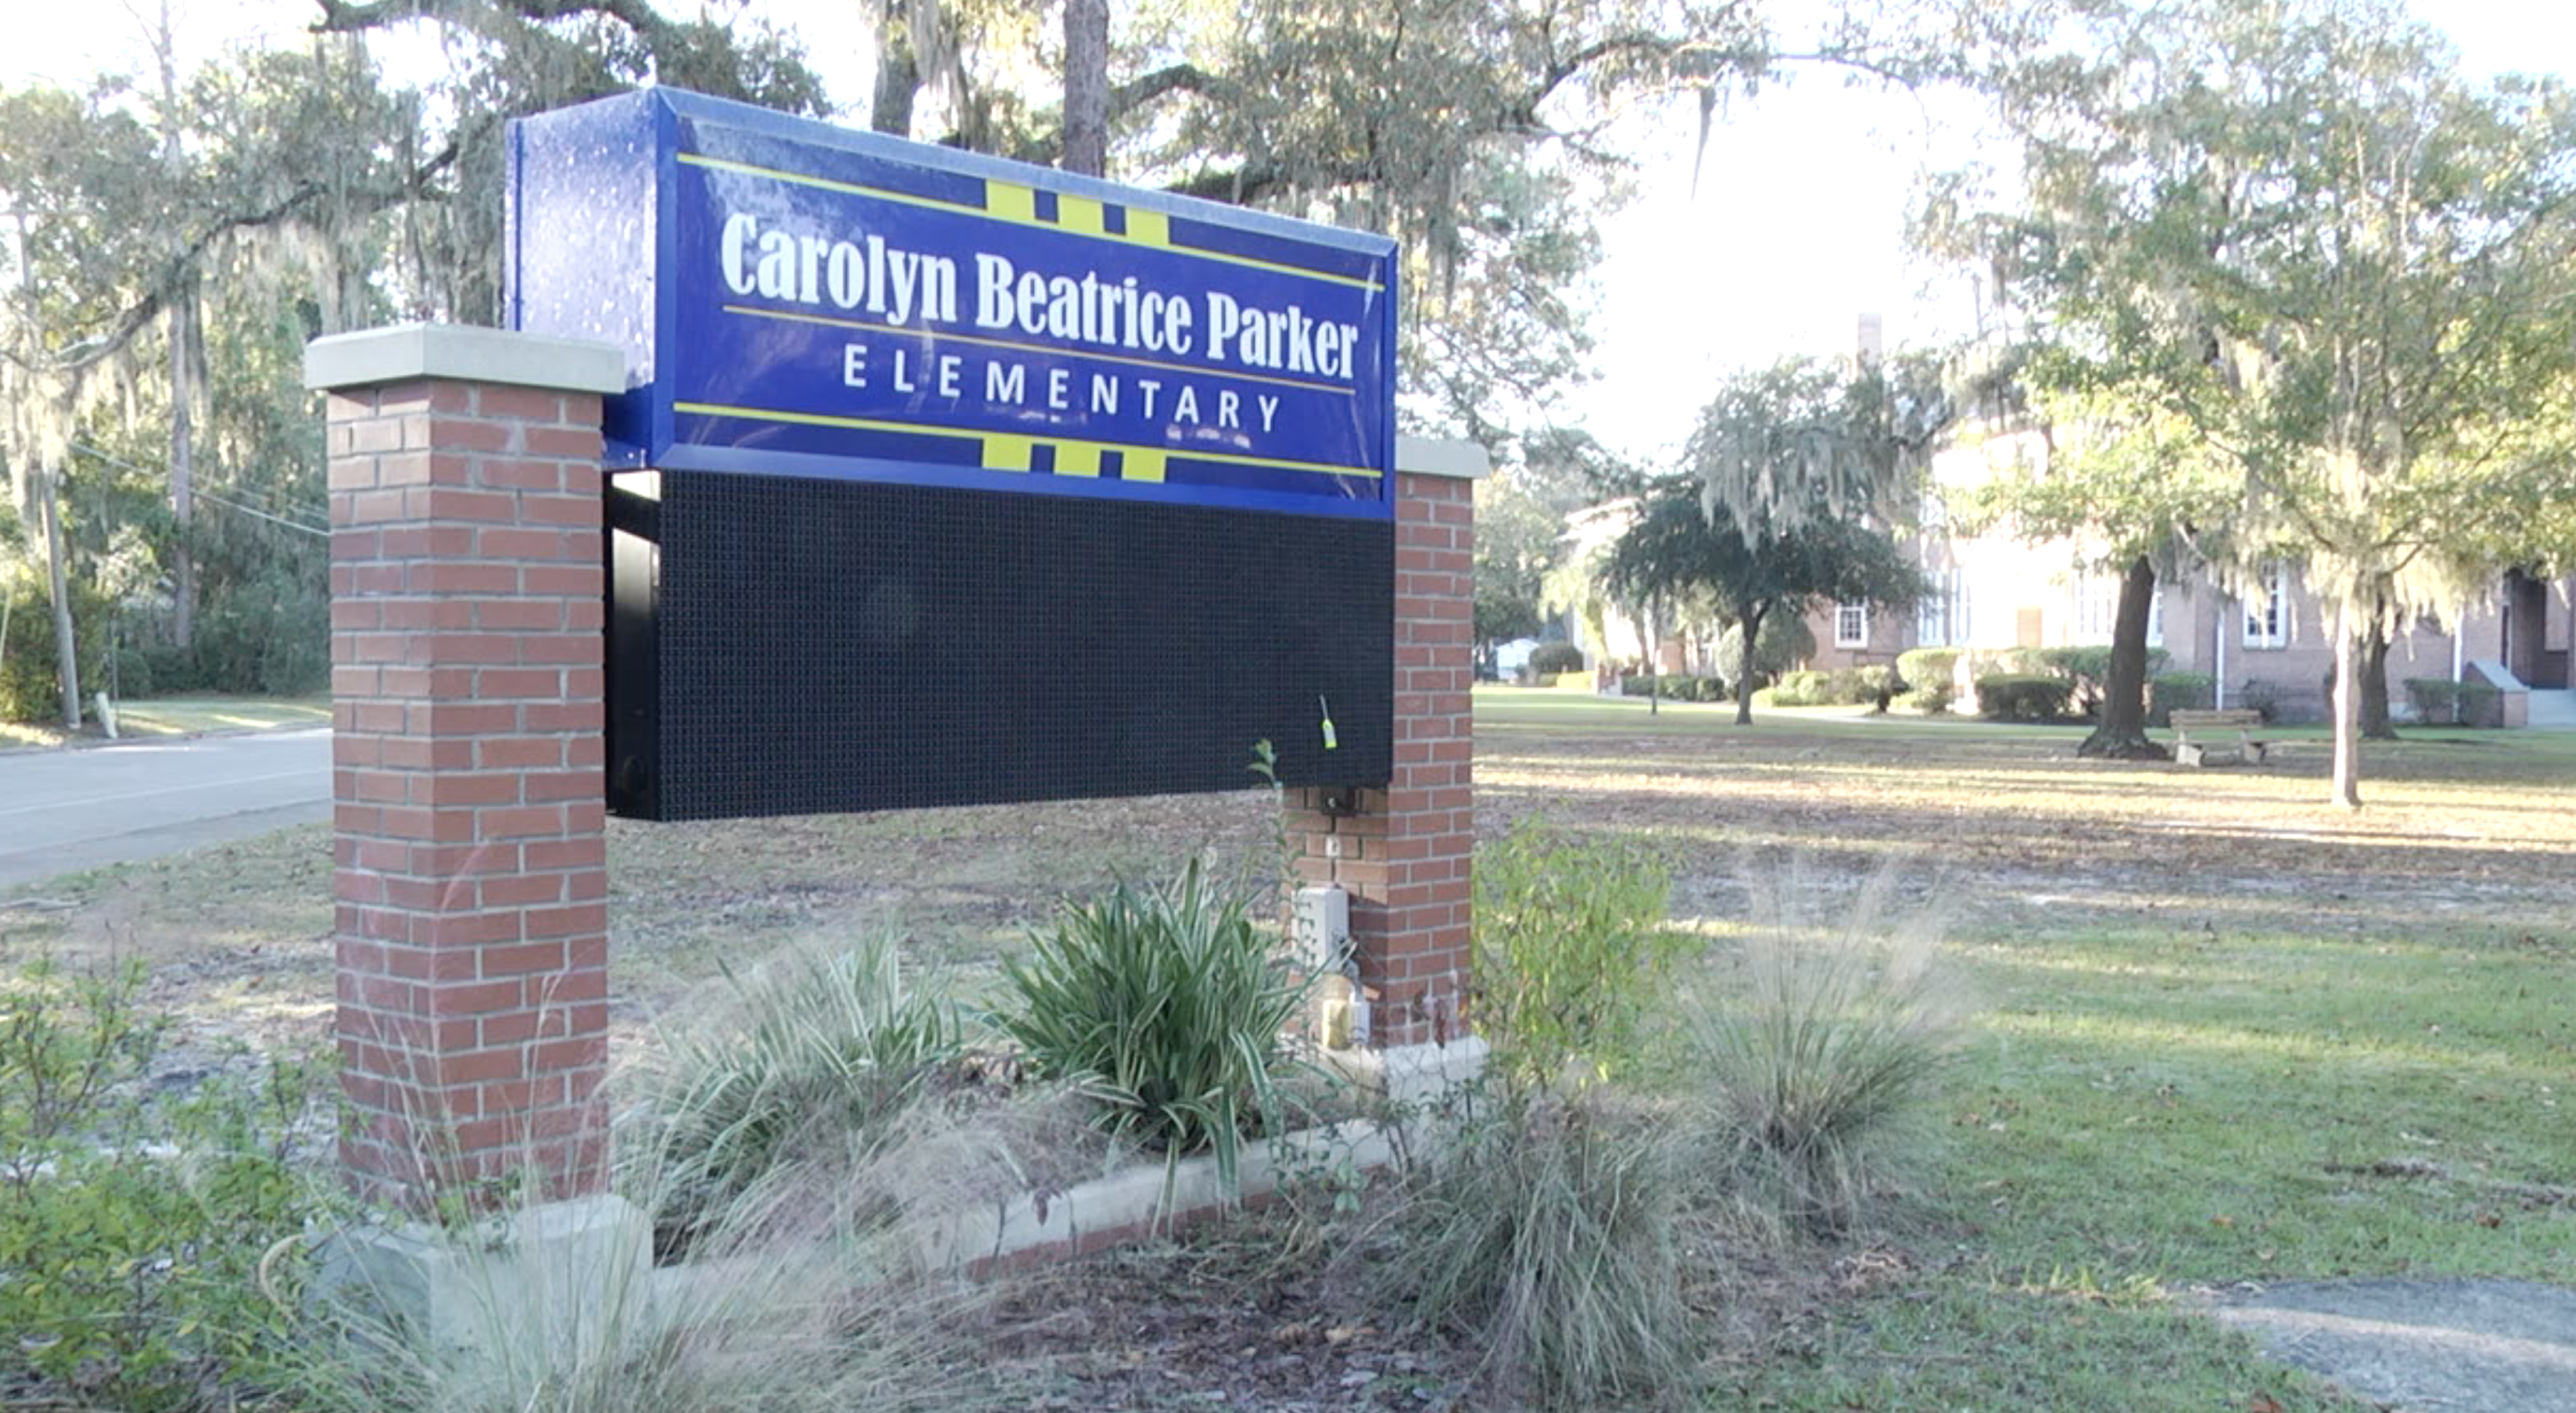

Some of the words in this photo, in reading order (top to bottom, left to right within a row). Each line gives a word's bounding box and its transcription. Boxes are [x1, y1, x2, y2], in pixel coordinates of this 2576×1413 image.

[721, 213, 957, 326] Carolyn
[975, 253, 1193, 355] Beatrice
[1206, 291, 1358, 379] Parker
[844, 344, 1279, 432] ELEMENTARY
